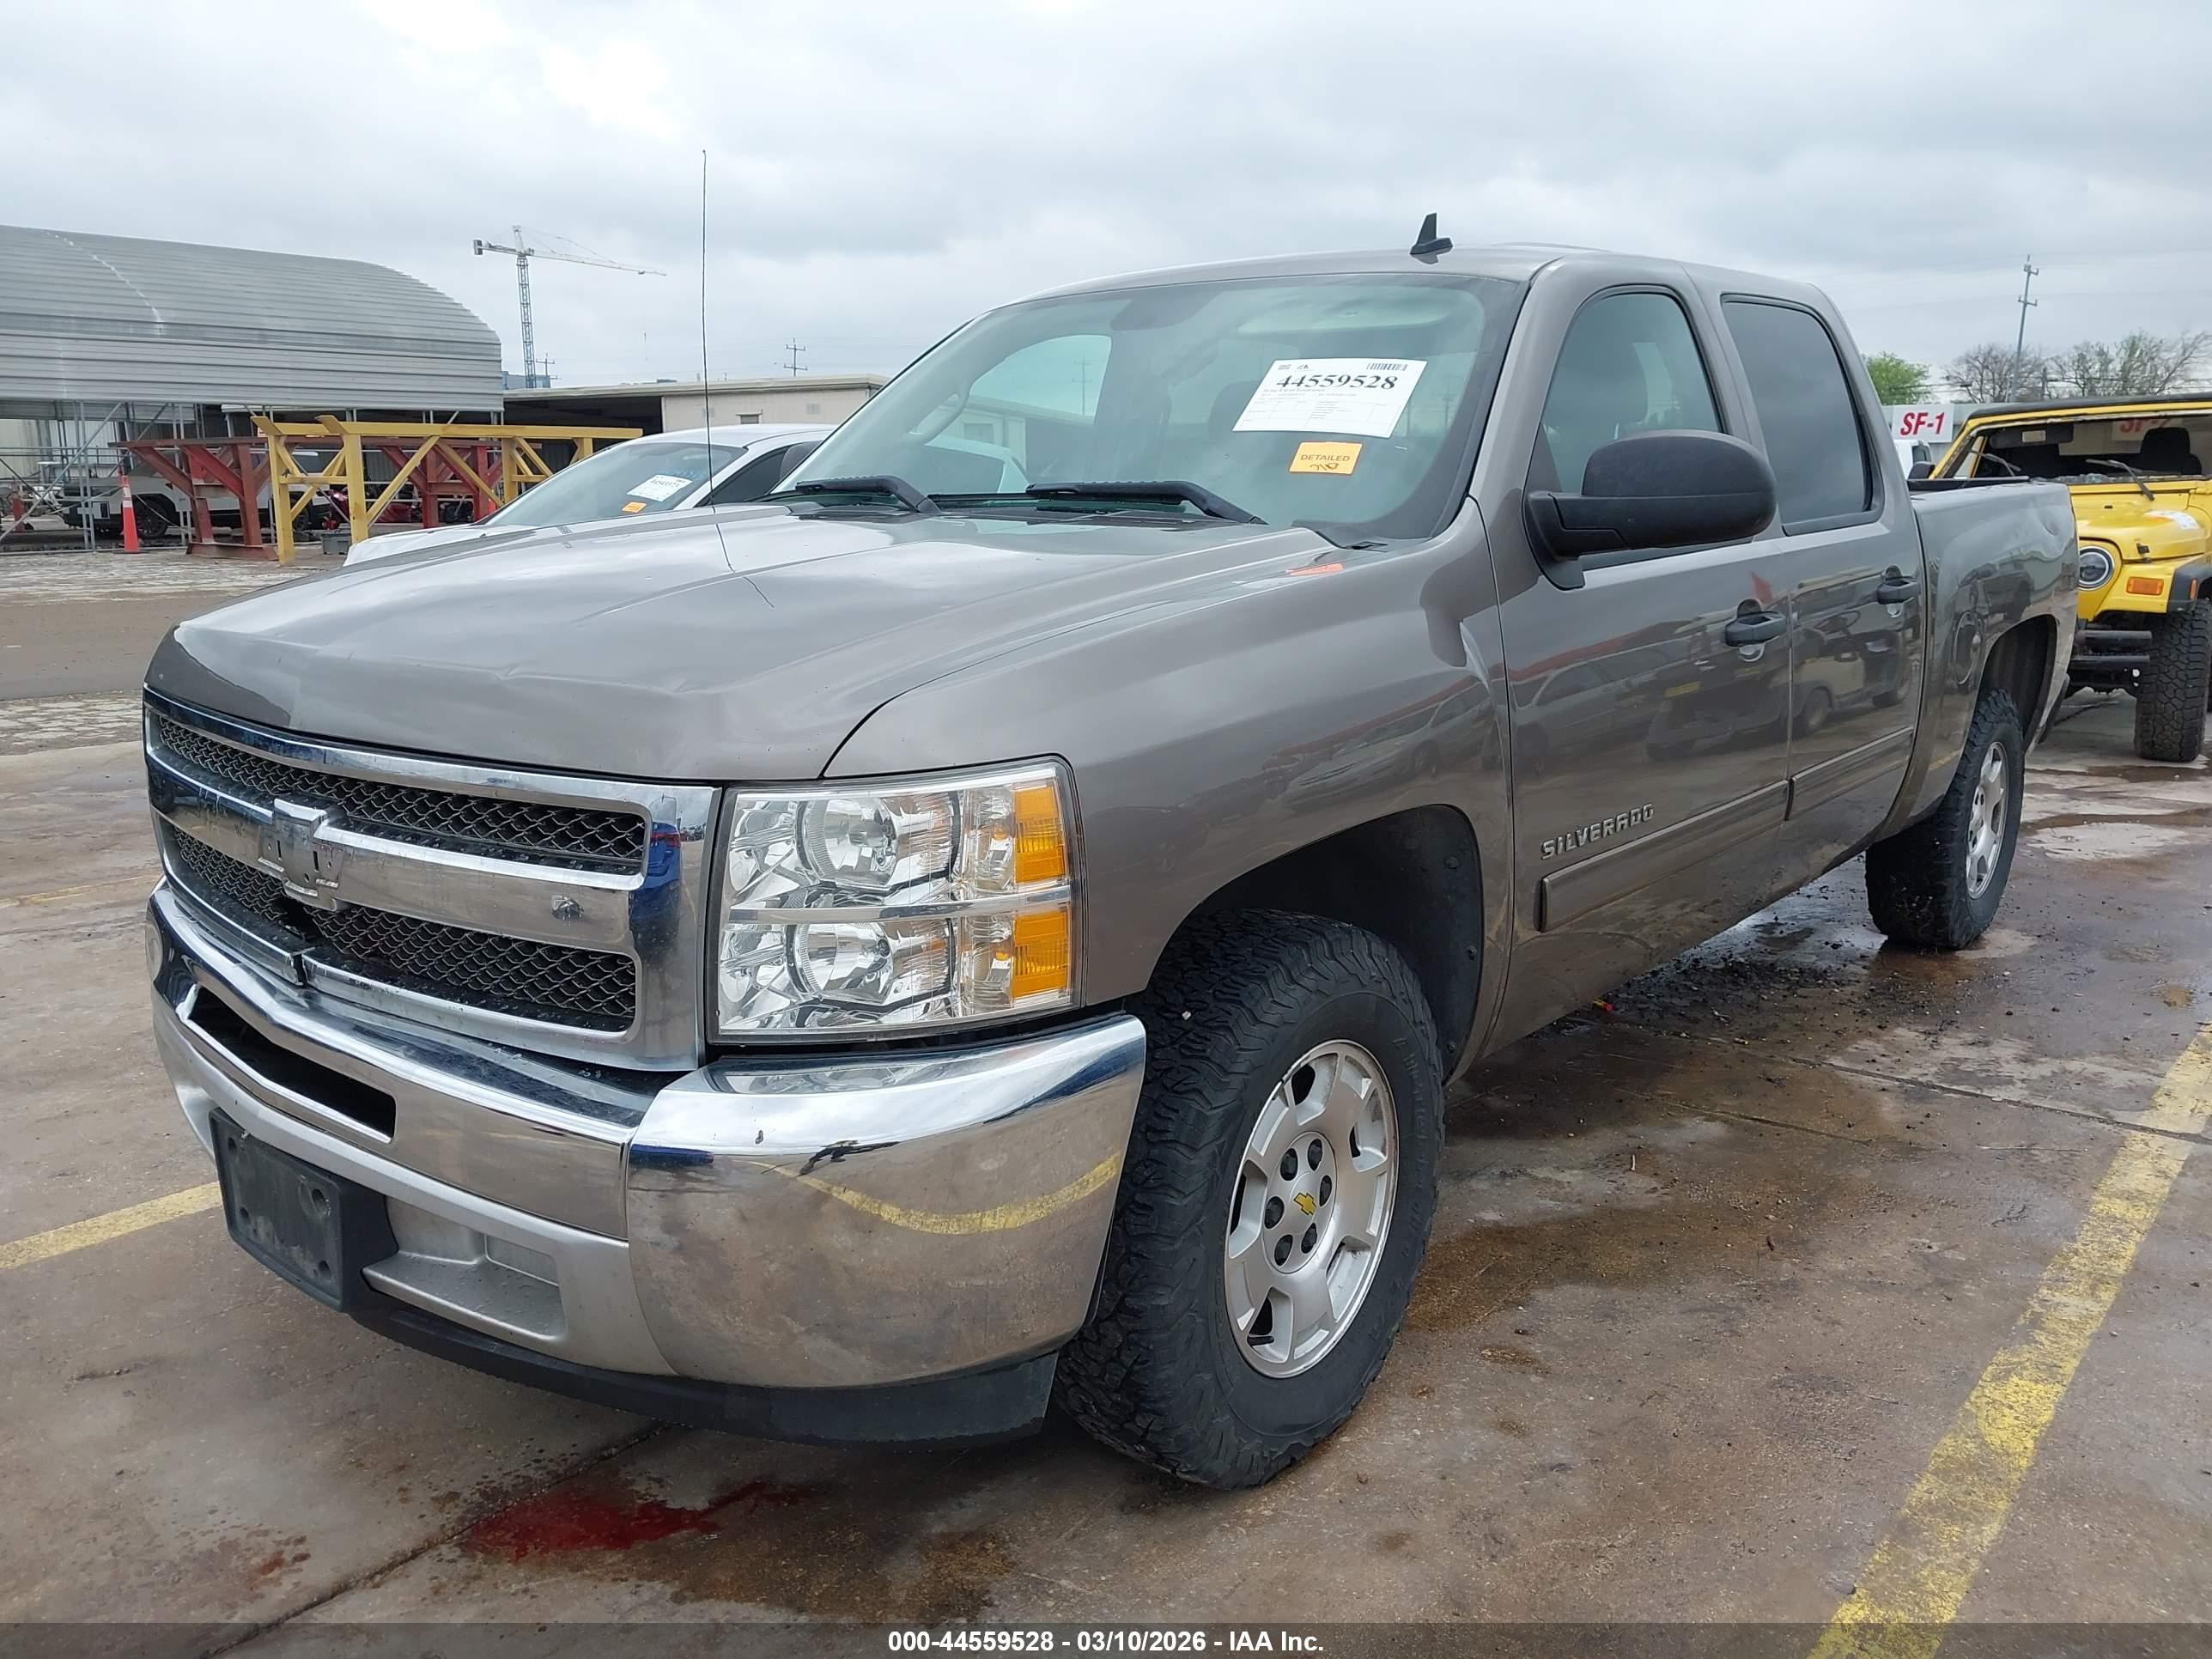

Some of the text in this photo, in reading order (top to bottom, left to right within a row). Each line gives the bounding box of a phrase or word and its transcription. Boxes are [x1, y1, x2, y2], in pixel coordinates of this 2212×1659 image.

[1276, 374, 1399, 390] 44559528
[1900, 412, 1945, 435] SF-1
[1540, 803, 1655, 860] SILVERADO
